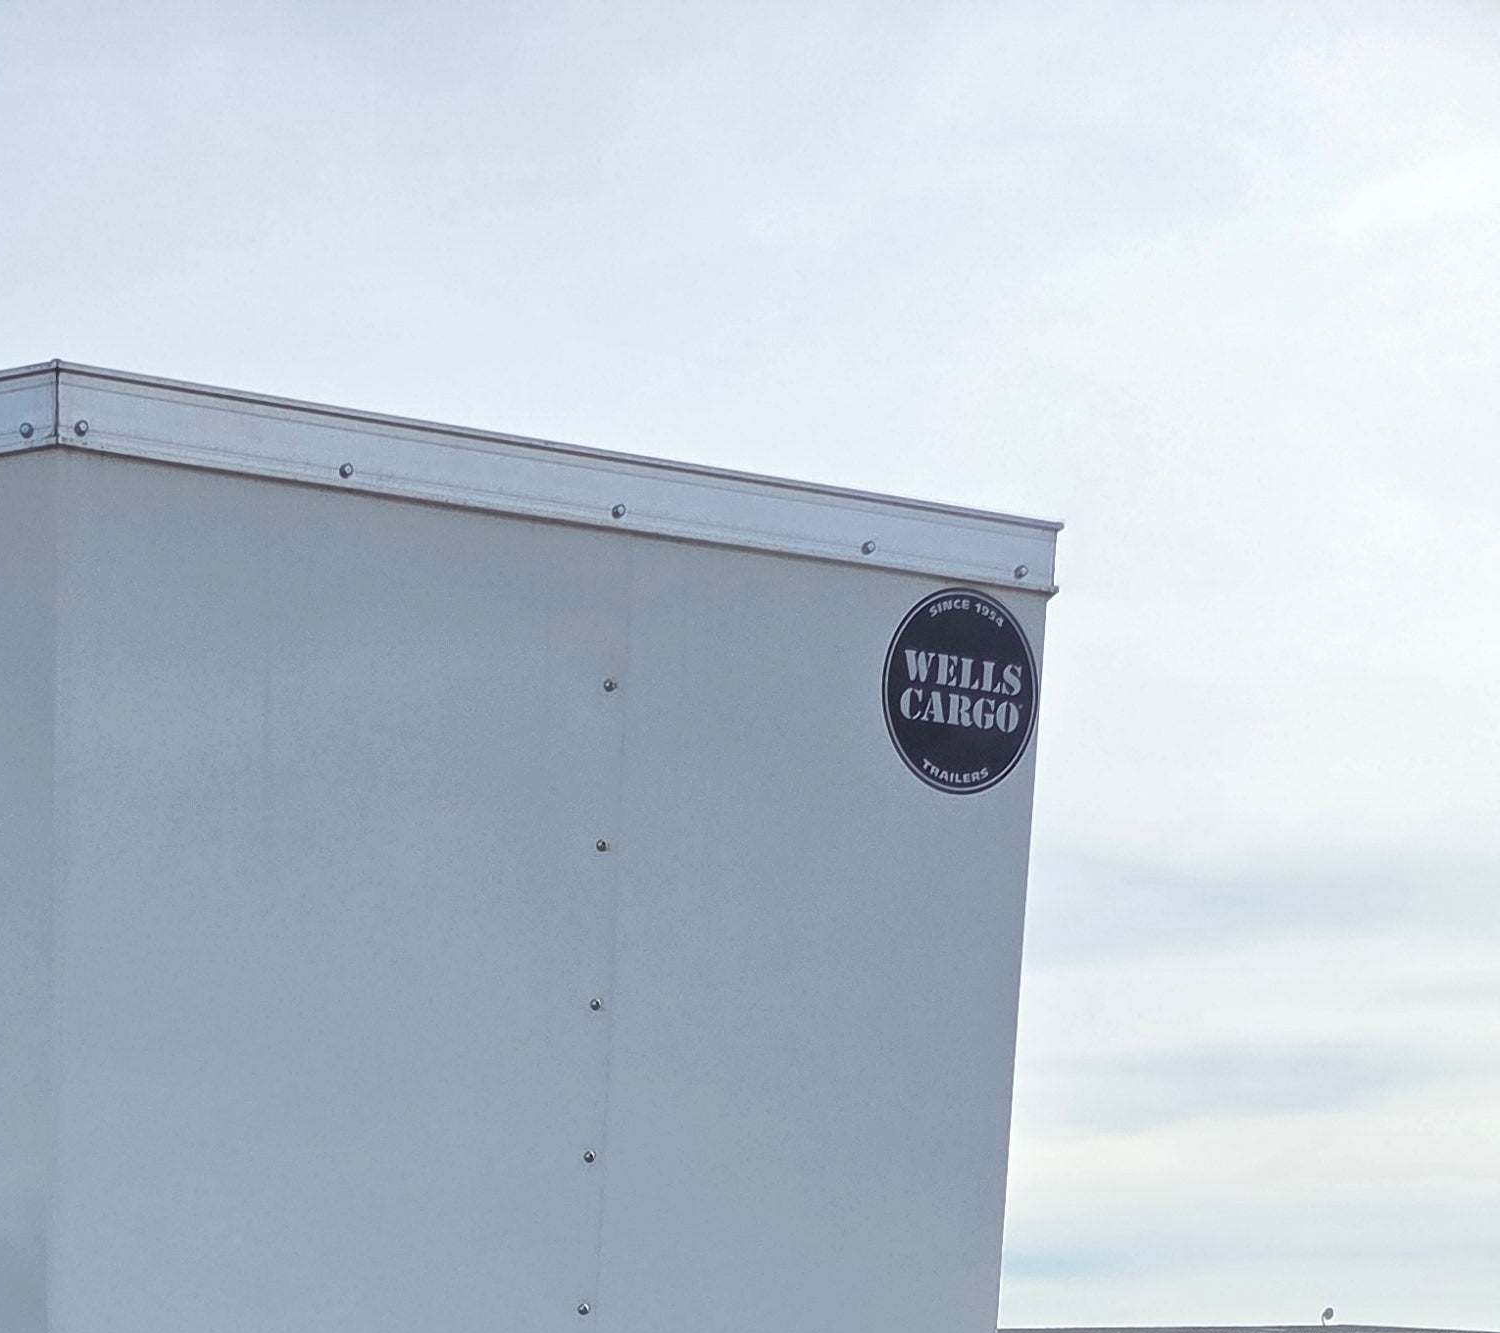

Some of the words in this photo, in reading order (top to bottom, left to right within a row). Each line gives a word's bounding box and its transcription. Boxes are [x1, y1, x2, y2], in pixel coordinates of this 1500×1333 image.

[929, 599, 970, 618] SINCE
[974, 603, 1004, 628] 1954
[904, 649, 1023, 697] WELLS
[900, 687, 1020, 734] CARGO
[922, 758, 990, 784] TRAILERS
